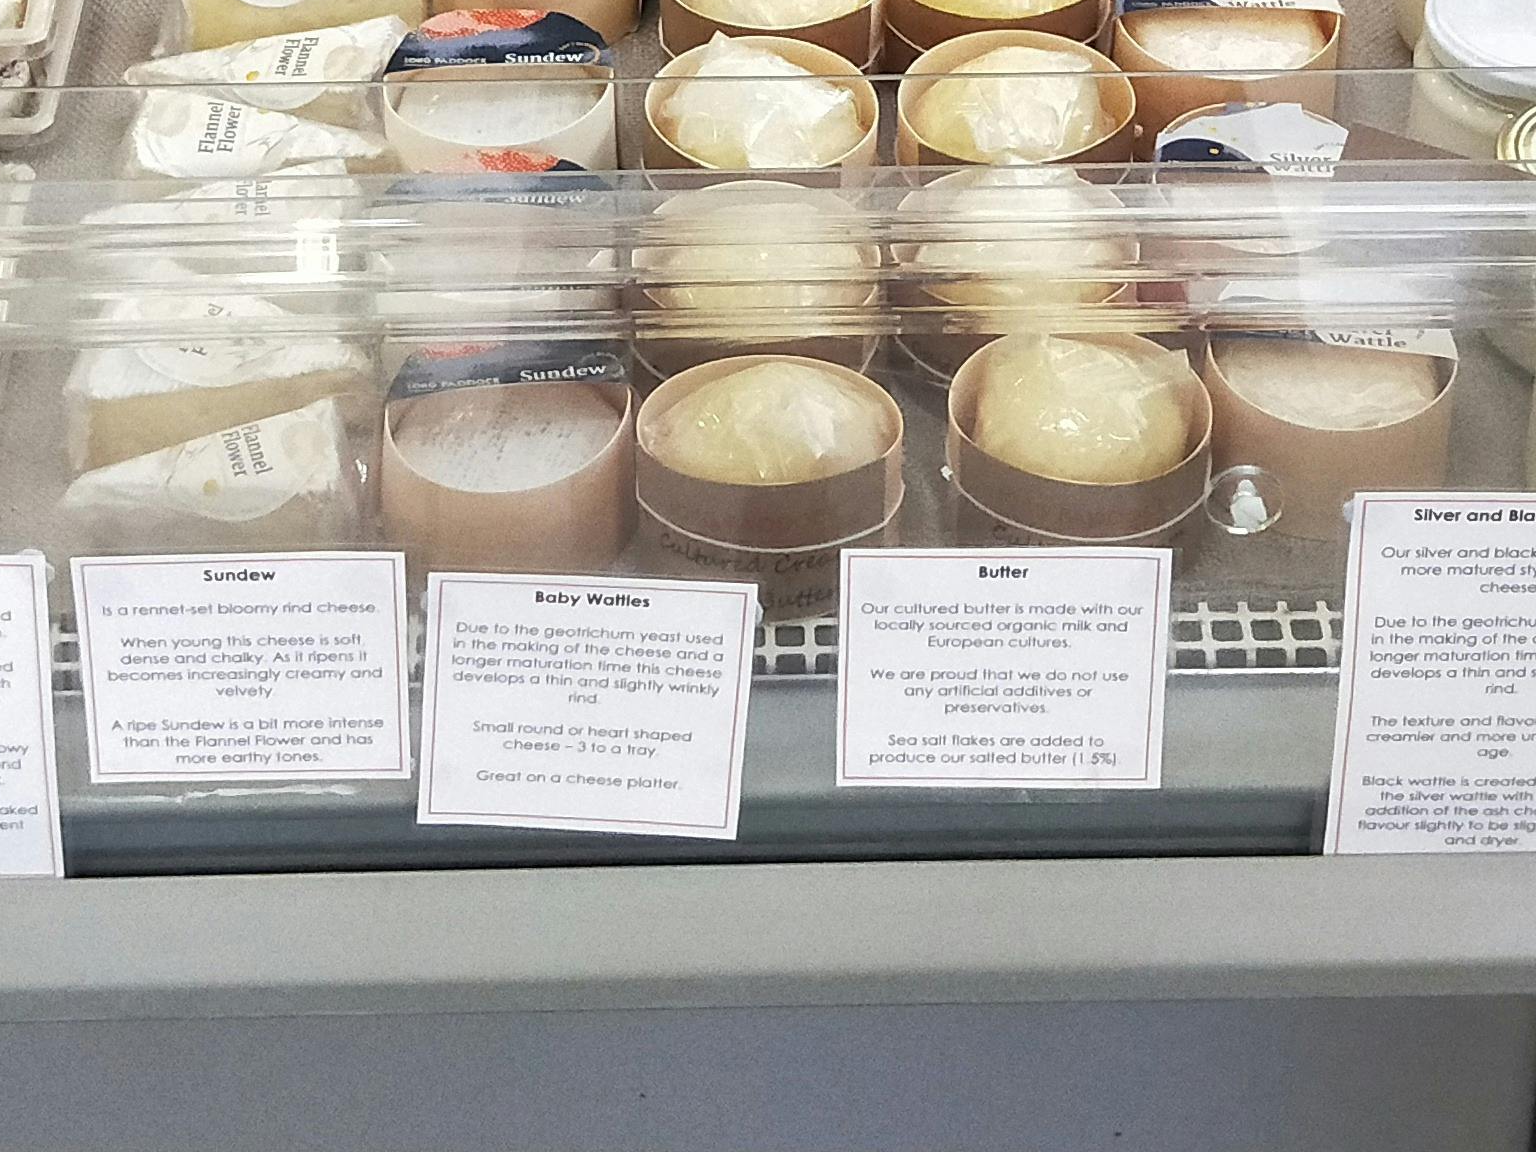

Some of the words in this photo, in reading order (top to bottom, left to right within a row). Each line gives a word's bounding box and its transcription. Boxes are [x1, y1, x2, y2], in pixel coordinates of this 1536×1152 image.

[1227, 0, 1297, 9] Wattle
[275, 38, 302, 77] Flower
[292, 37, 320, 78] Flannel
[504, 51, 585, 64] Sundew
[197, 101, 225, 154] Flannel
[216, 104, 242, 153] Flower
[1268, 151, 1334, 163] Silver
[1328, 332, 1408, 349] Wattle
[519, 363, 608, 383] Sundew
[220, 429, 248, 478] Flower
[239, 423, 273, 475] Flannel
[1413, 507, 1462, 522] Silver
[1465, 508, 1503, 522] and
[202, 568, 276, 582] Sundew
[978, 564, 1029, 579] Butter
[1400, 565, 1442, 576] more
[1446, 562, 1516, 577] matured
[534, 589, 581, 607] Baby
[586, 591, 650, 608] Wattles
[860, 601, 889, 616] Our
[893, 601, 959, 617] cultured
[963, 602, 1011, 617] butter
[1013, 602, 1024, 617] is
[1027, 602, 1077, 618] made
[1079, 602, 1113, 618] with
[1116, 605, 1144, 618] our
[873, 618, 925, 633] locally
[928, 618, 993, 633] sourced
[996, 618, 1057, 636] organic
[1061, 618, 1092, 631] milk
[1095, 620, 1128, 632] and
[927, 634, 1004, 650] European
[472, 719, 514, 737] Small
[517, 721, 564, 739] round
[567, 726, 584, 740] or
[587, 725, 629, 742] heart
[632, 727, 693, 747] shaped
[887, 733, 918, 747] Sea
[921, 733, 947, 746] salt
[951, 733, 995, 748] flakes
[999, 736, 1026, 748] are
[1029, 734, 1084, 749] added
[1088, 735, 1105, 749] to
[174, 753, 217, 764] more
[220, 750, 272, 766] earthy
[868, 750, 936, 767] produce
[939, 752, 965, 764] our
[968, 750, 1017, 764] salted
[1020, 751, 1067, 765] butter
[475, 768, 522, 783] Great
[525, 772, 546, 783] on
[549, 773, 562, 784] a
[565, 772, 623, 787] cheese
